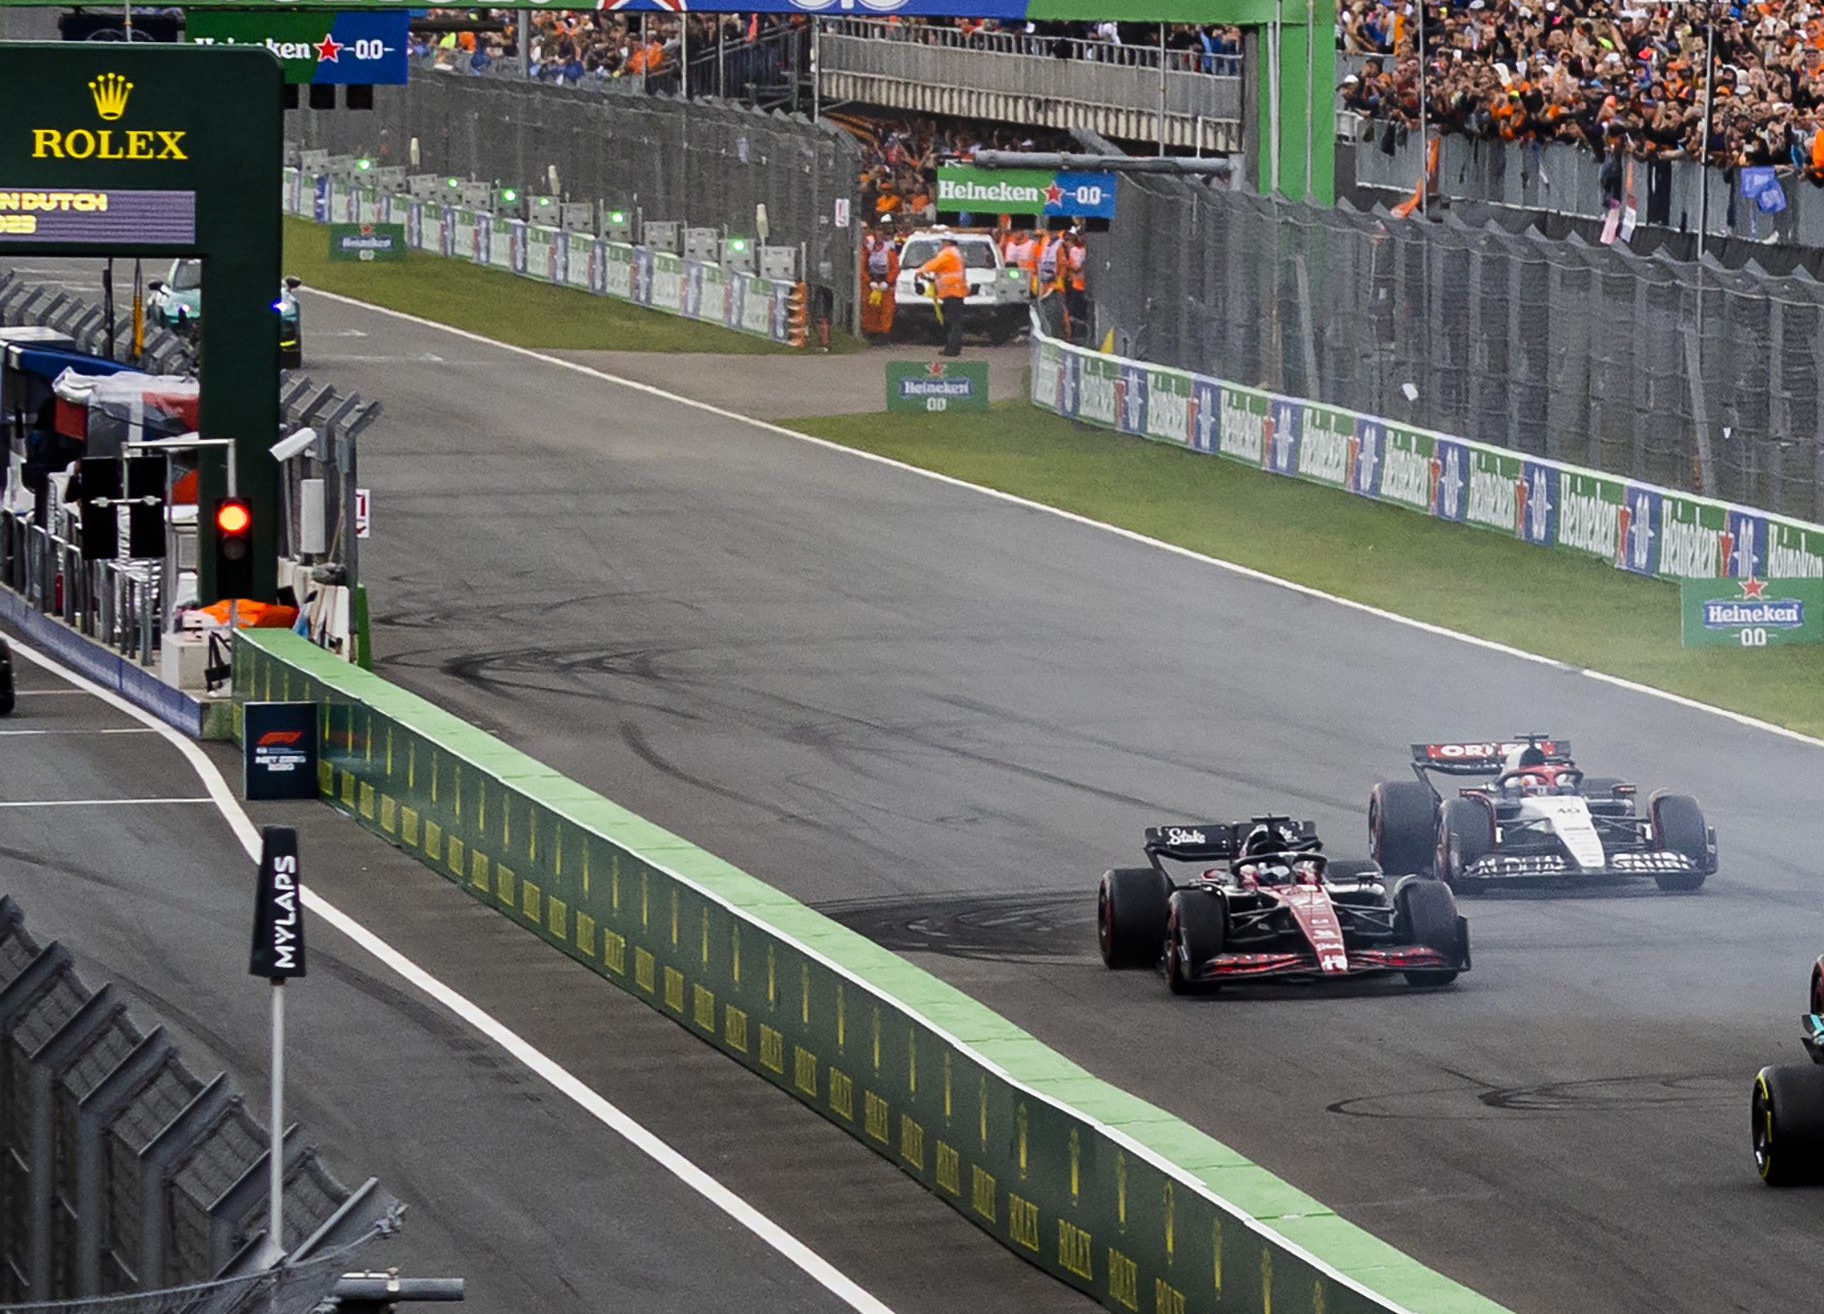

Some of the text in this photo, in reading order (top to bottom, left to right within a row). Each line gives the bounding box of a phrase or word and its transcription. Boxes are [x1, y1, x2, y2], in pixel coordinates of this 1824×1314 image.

[31, 129, 188, 160] ROLEX
[938, 180, 1038, 203] Heineken
[20, 193, 108, 212] DUTCH
[904, 380, 970, 395] Heineken
[1709, 604, 1798, 624] Heineken
[1169, 827, 1206, 845] Stake
[275, 855, 296, 968] MYLAPS
